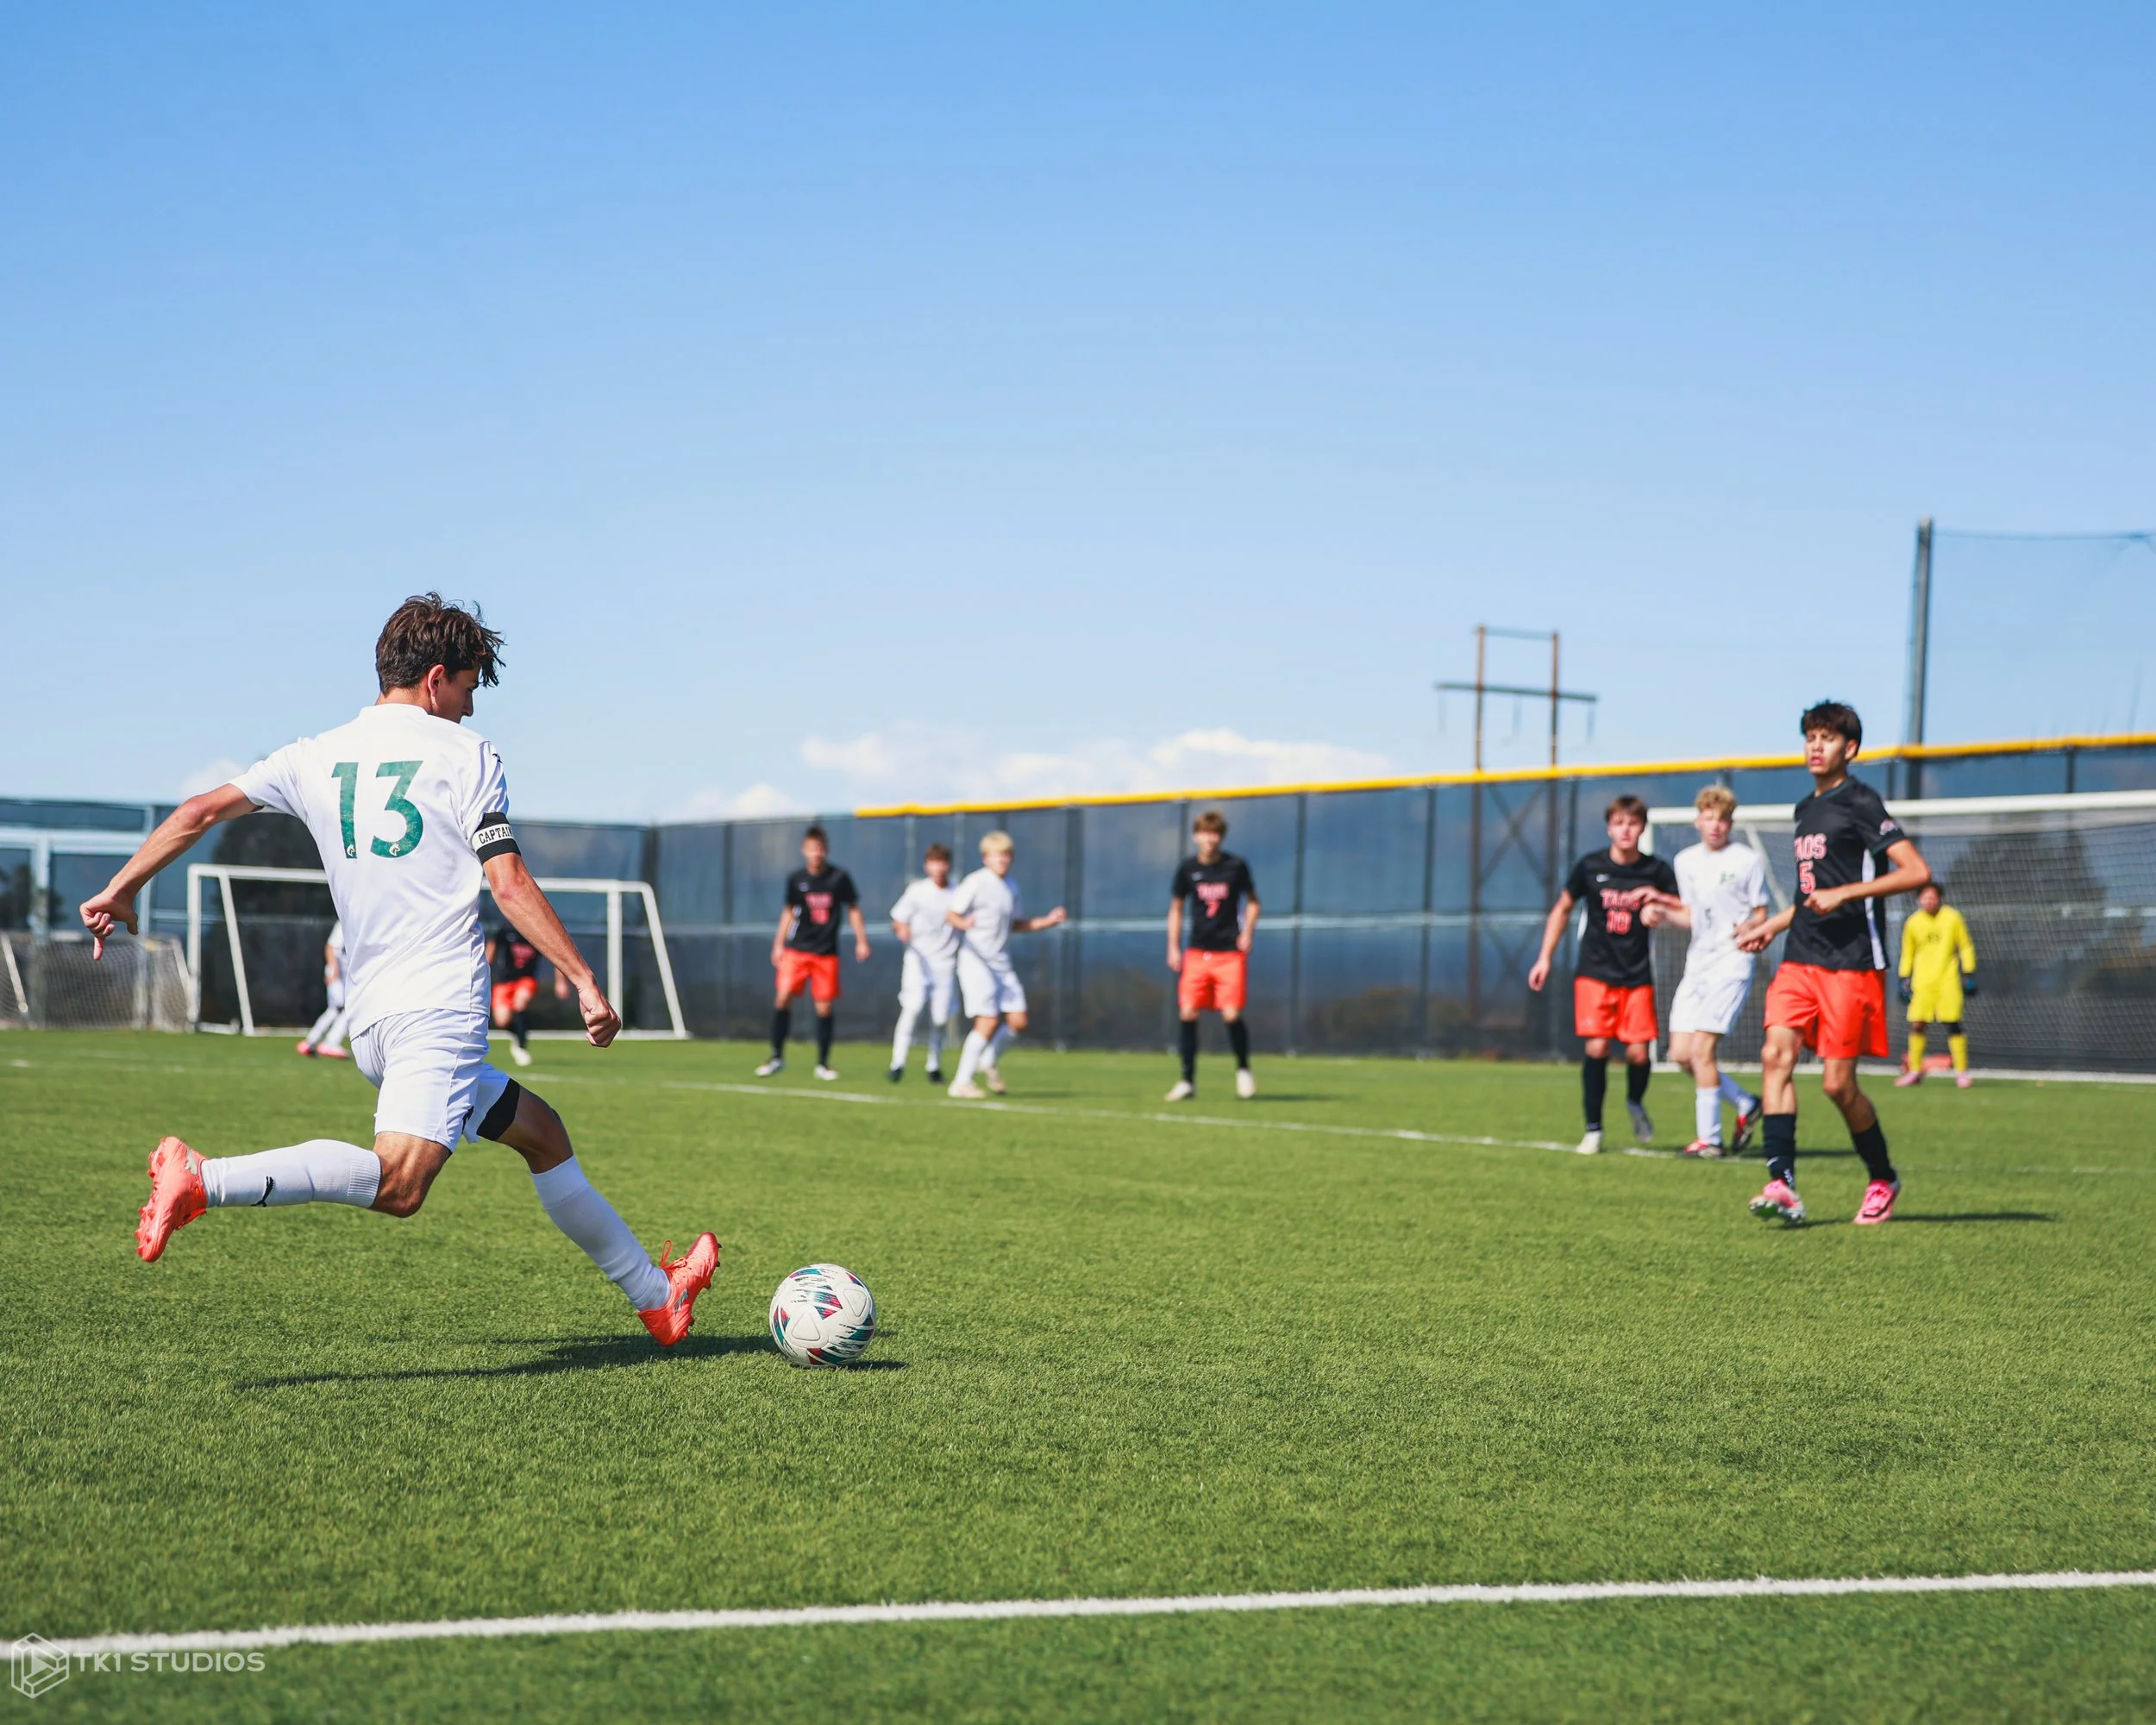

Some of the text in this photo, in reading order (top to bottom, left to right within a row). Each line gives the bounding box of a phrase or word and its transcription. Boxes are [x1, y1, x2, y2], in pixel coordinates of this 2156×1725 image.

[331, 760, 423, 858] 13
[1799, 861, 1816, 894] 5
[1607, 910, 1633, 935] 10
